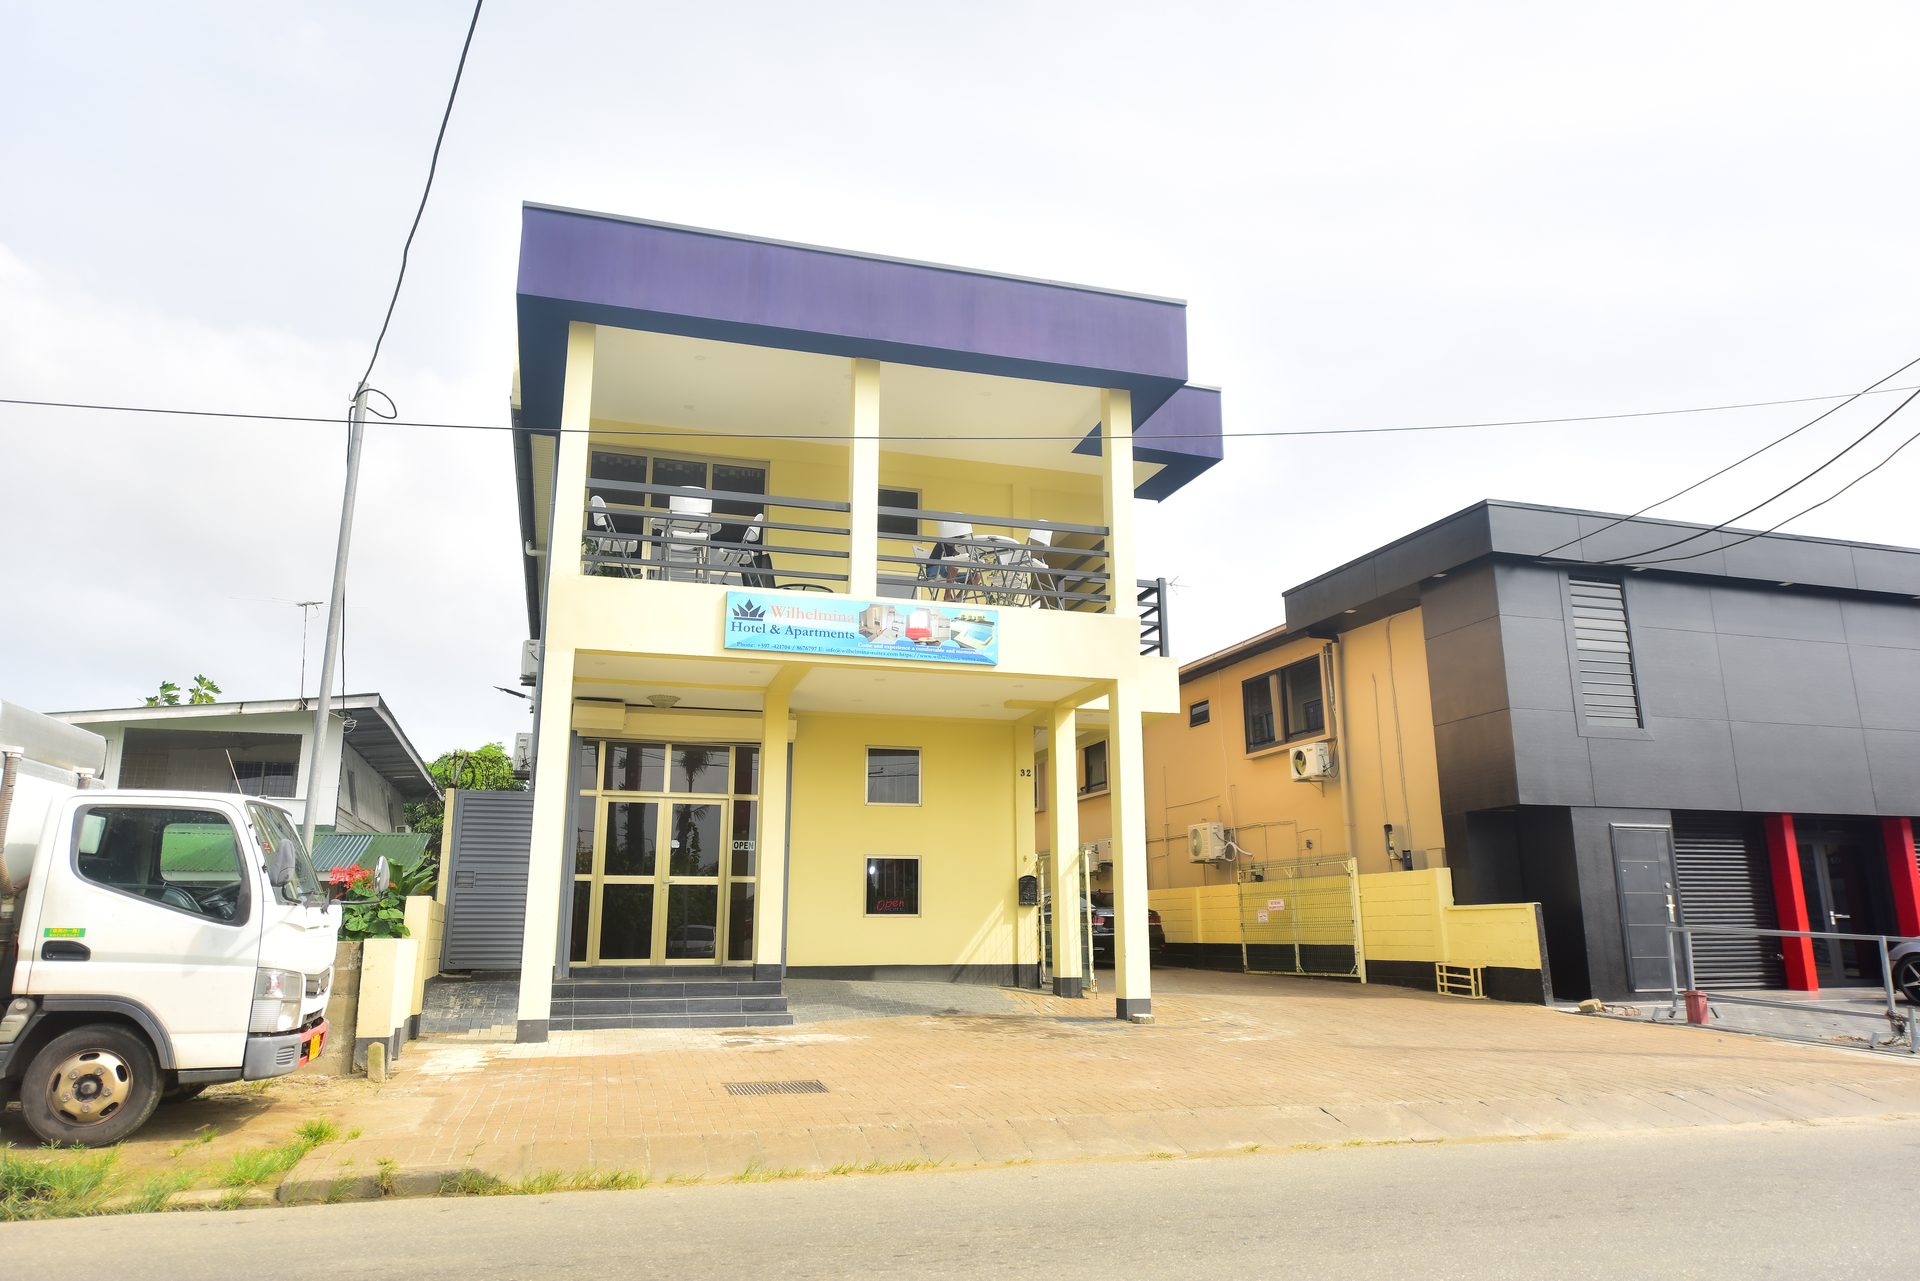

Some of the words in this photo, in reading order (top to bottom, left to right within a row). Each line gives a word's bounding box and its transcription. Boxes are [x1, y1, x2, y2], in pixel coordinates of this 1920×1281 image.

[770, 605, 855, 623] Wilhelmina
[731, 621, 766, 634] Hotel
[769, 624, 781, 635] &
[785, 625, 855, 640] Apartments
[1020, 768, 1031, 777] 32
[733, 841, 754, 850] OPEN
[876, 899, 905, 911] Open
